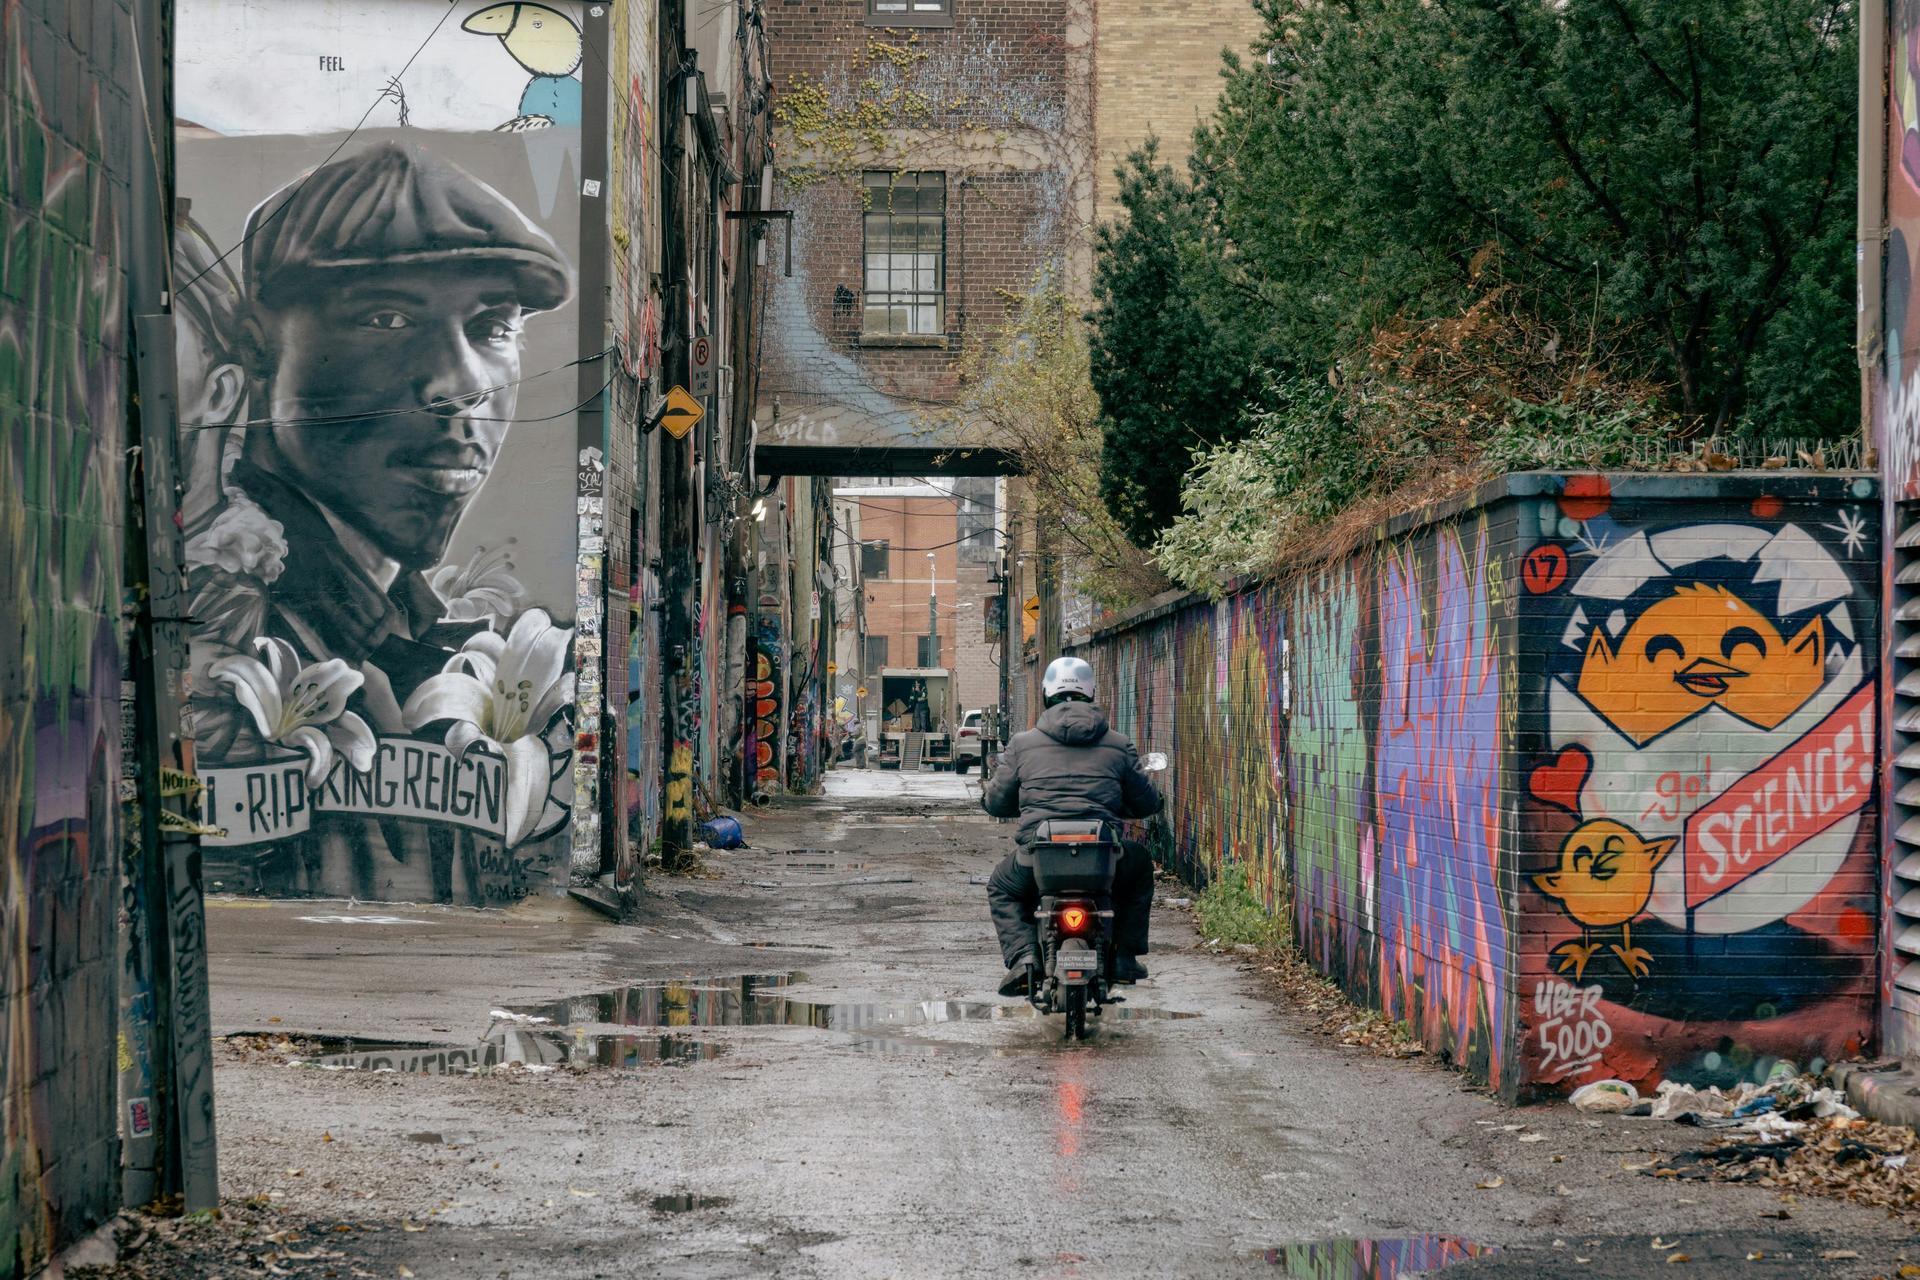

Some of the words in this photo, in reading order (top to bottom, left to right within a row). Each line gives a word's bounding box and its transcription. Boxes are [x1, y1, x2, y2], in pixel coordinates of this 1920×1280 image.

[319, 56, 345, 72] FEEL
[1529, 555, 1559, 583] 17
[1655, 754, 1711, 822] go!
[1535, 980, 1605, 1019] UBER
[1539, 1017, 1612, 1070] 5000
